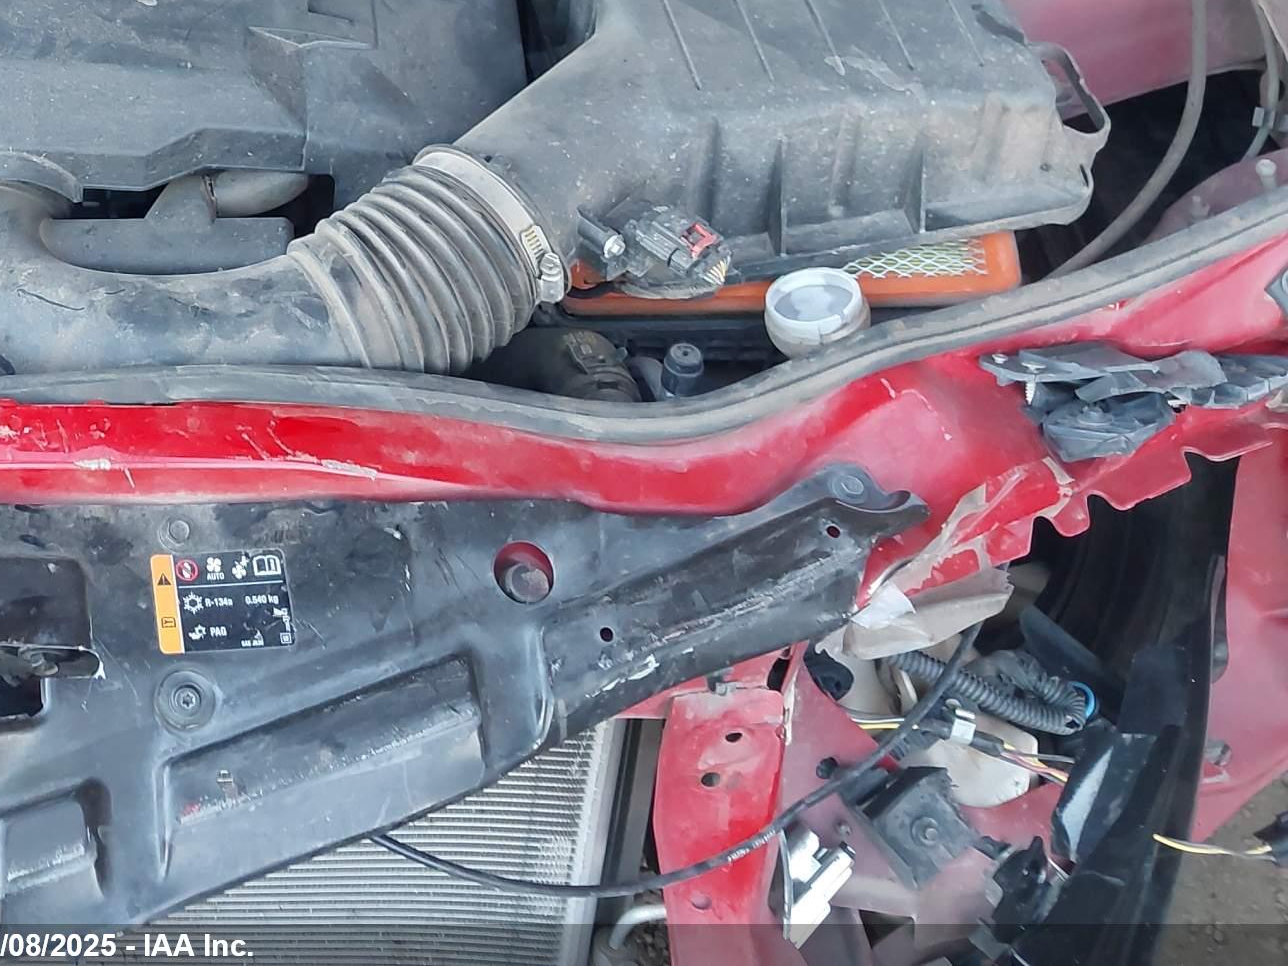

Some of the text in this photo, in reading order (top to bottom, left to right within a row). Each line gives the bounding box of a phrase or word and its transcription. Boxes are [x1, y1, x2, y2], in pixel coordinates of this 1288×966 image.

[204, 597, 233, 608] R-134a
[245, 594, 279, 605] 0.540 kg
